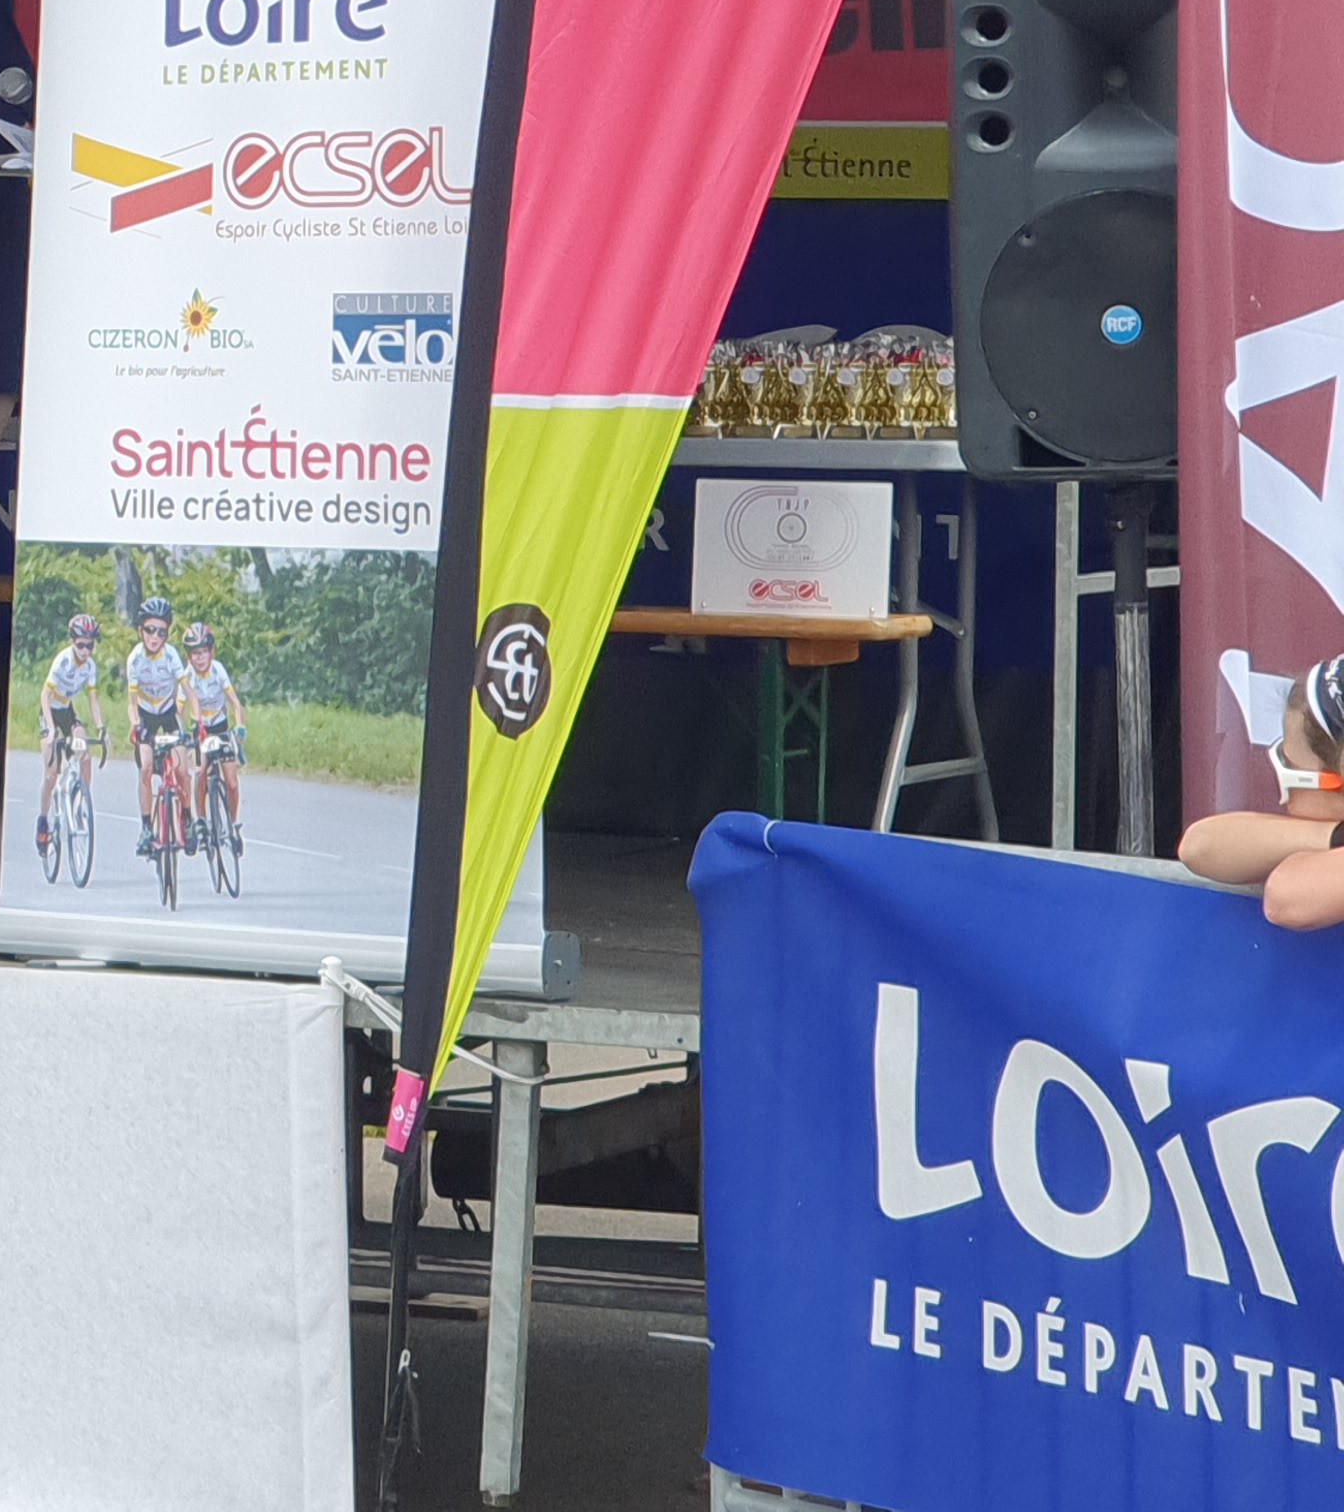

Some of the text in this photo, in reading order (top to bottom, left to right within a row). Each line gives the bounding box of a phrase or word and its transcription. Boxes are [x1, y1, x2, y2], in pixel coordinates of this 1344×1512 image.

[162, 56, 389, 86] LE DÉPARTEMENT
[215, 214, 470, 243] Espoir Cycliste St Etienne Loi
[333, 294, 453, 314] CULTURE
[1106, 316, 1138, 333] RCF
[87, 328, 180, 350] CIZERON
[209, 328, 244, 350] BIO
[127, 365, 144, 378] bio
[145, 366, 169, 380] pour
[331, 367, 453, 384] SAINT-ETIENNE
[110, 488, 432, 535] Ville créative design
[874, 982, 1344, 1306] Loir
[870, 1278, 1344, 1452] LE DÉPARTE
